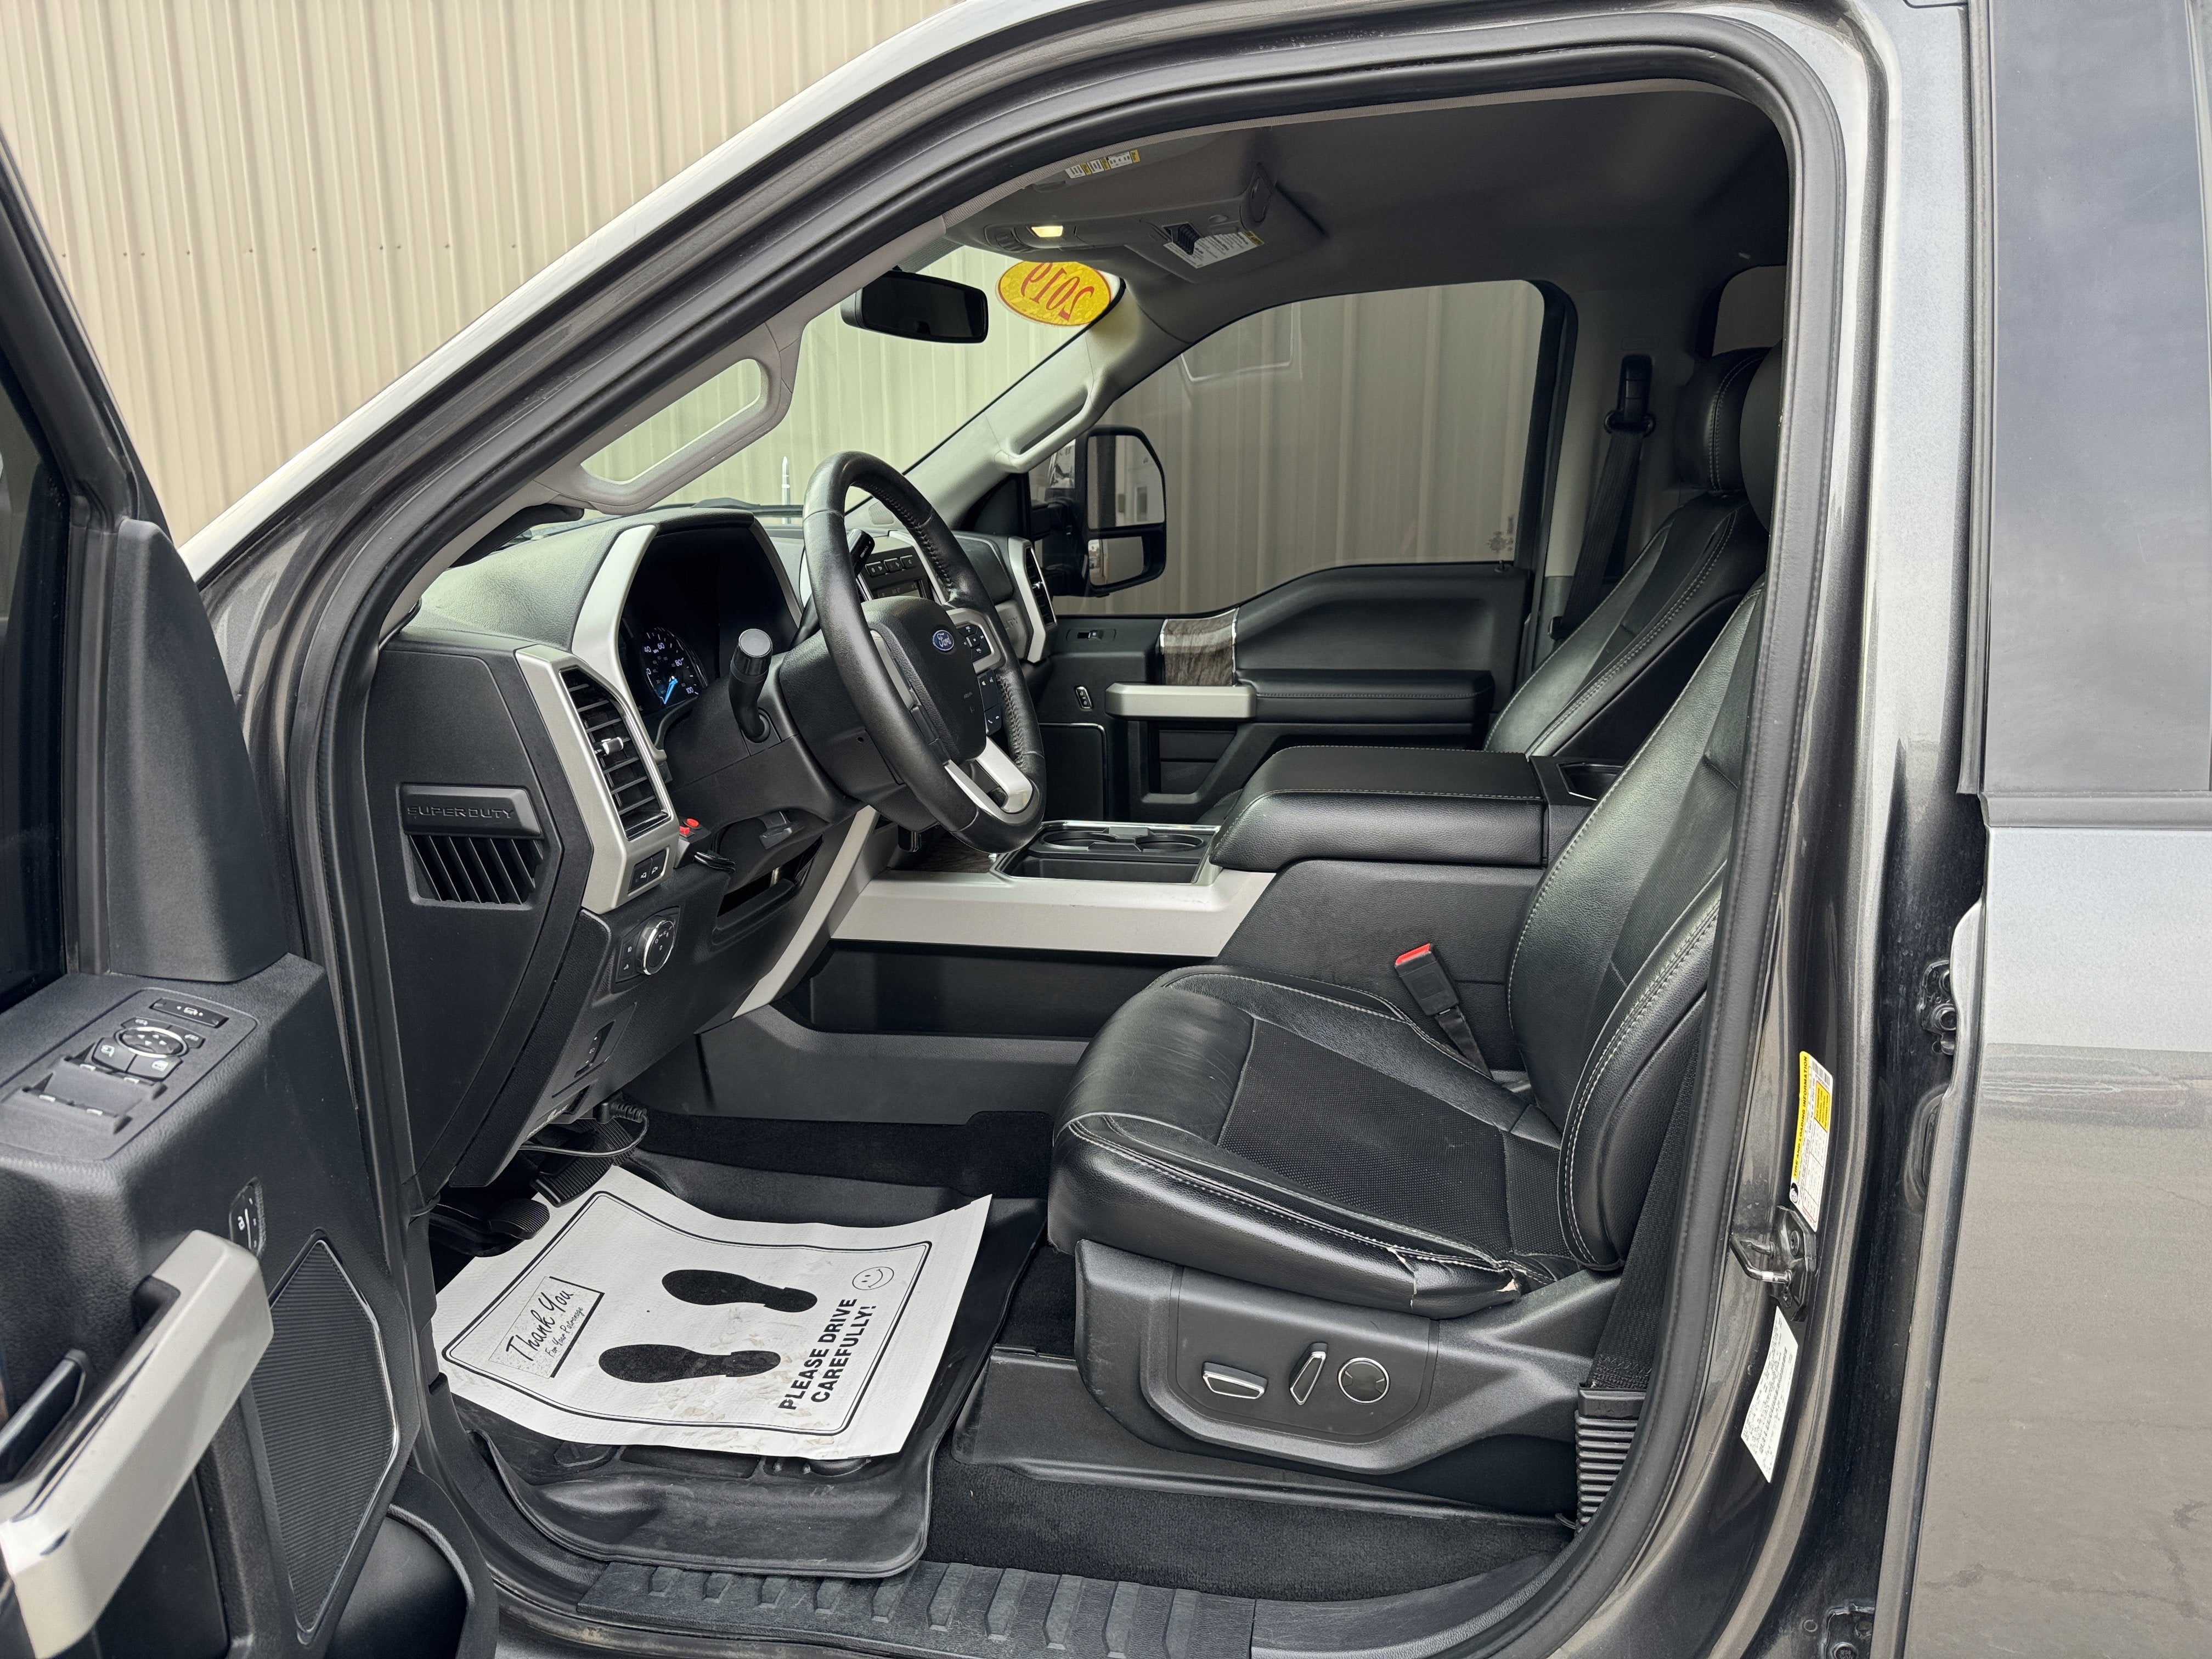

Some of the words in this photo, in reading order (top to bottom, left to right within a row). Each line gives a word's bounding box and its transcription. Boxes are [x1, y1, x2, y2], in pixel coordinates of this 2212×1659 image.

[936, 633, 952, 648] Ford
[506, 1310, 555, 1361] Thank
[538, 1290, 574, 1312] You
[545, 1346, 558, 1358] For
[560, 1307, 585, 1334] Patronage
[778, 1348, 830, 1410] PLEASE
[817, 1299, 857, 1342] DRIVE
[810, 1306, 876, 1402] CAREFULLY!
